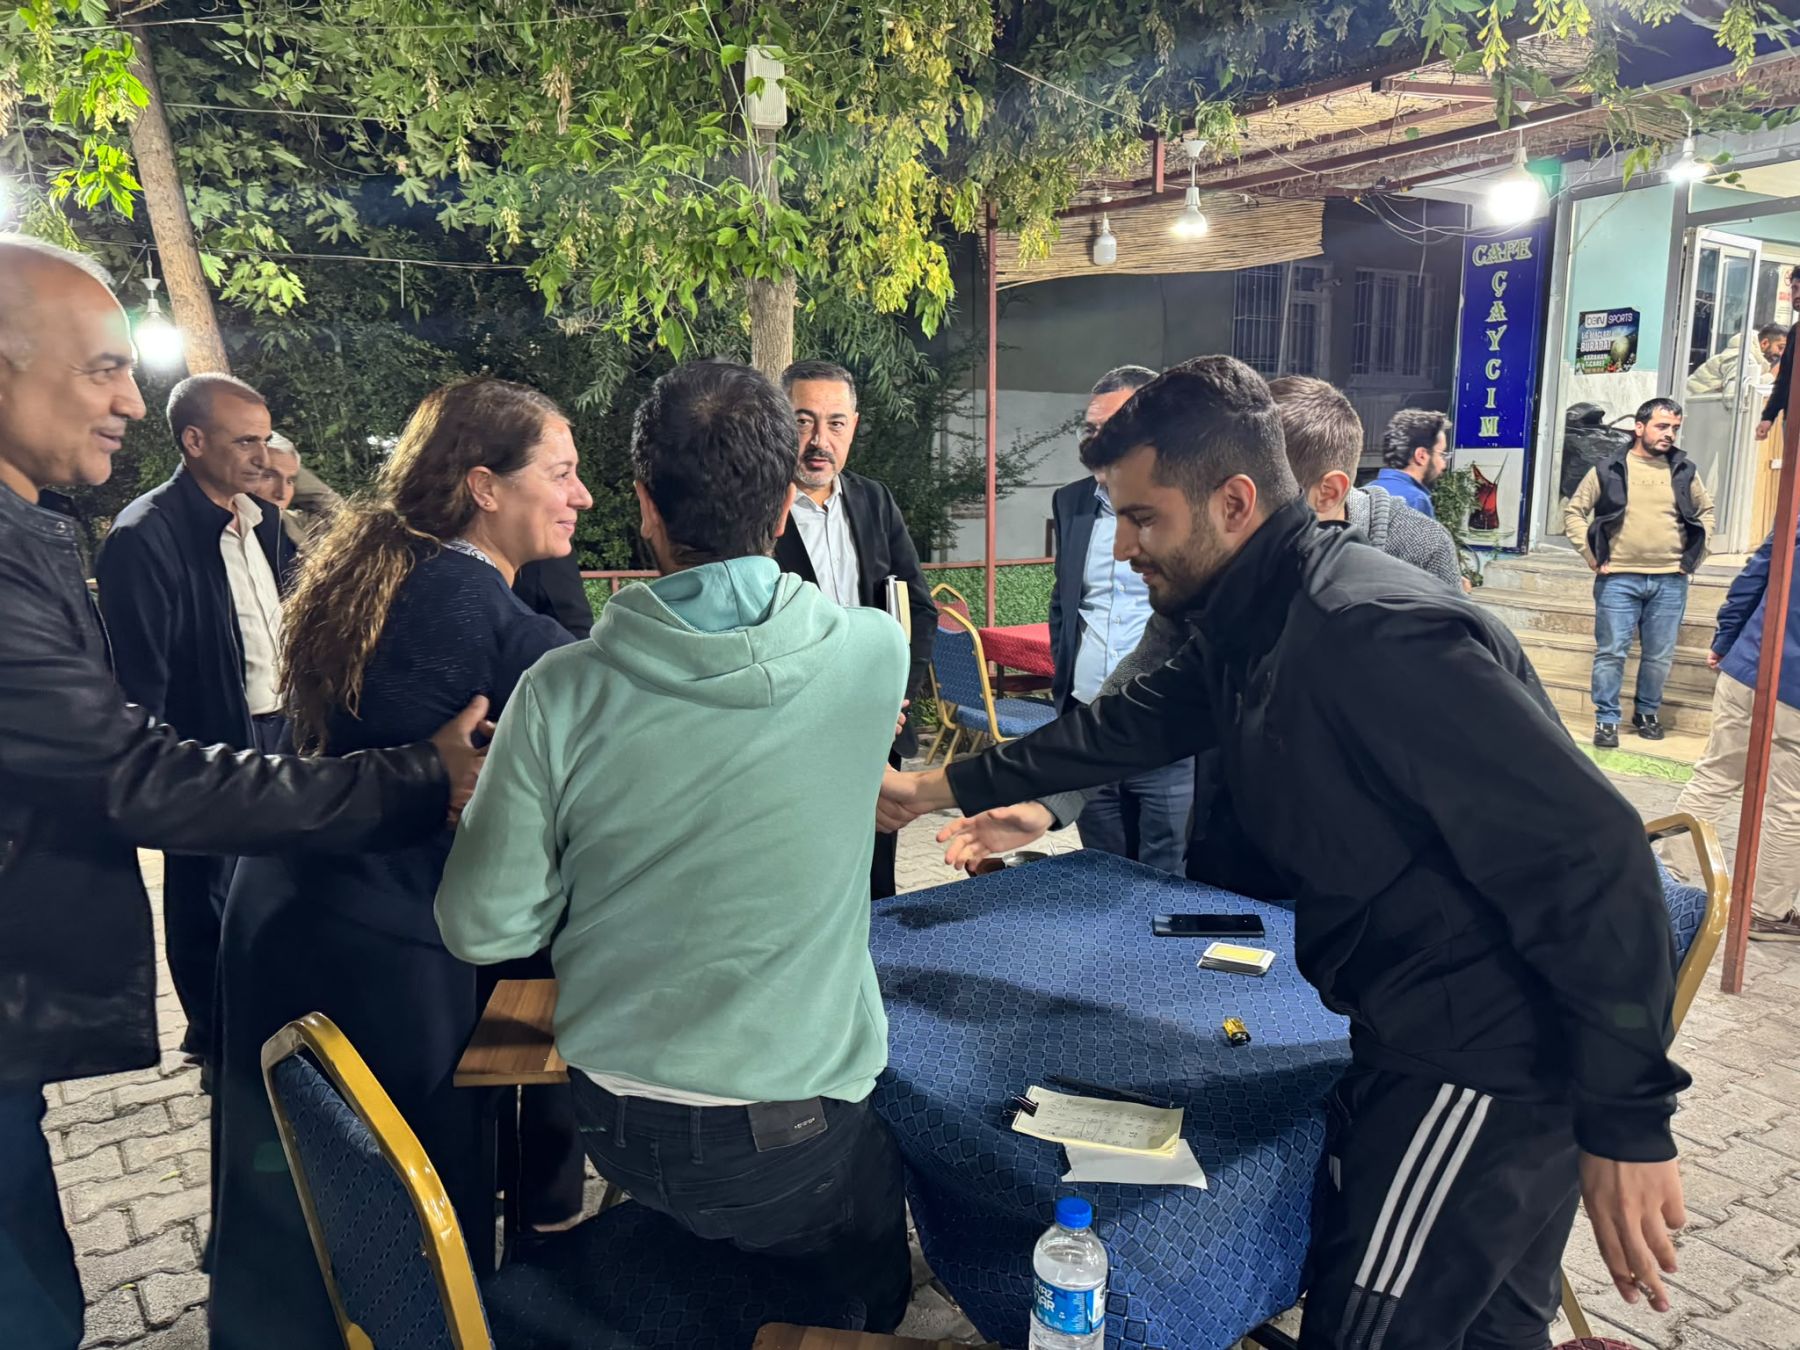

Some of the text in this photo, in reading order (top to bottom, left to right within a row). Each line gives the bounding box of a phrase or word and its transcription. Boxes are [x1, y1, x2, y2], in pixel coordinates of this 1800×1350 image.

[1472, 237, 1533, 267] CAFE
[1608, 313, 1633, 324] SPORTS
[1478, 271, 1508, 437] ÇAYCIM
